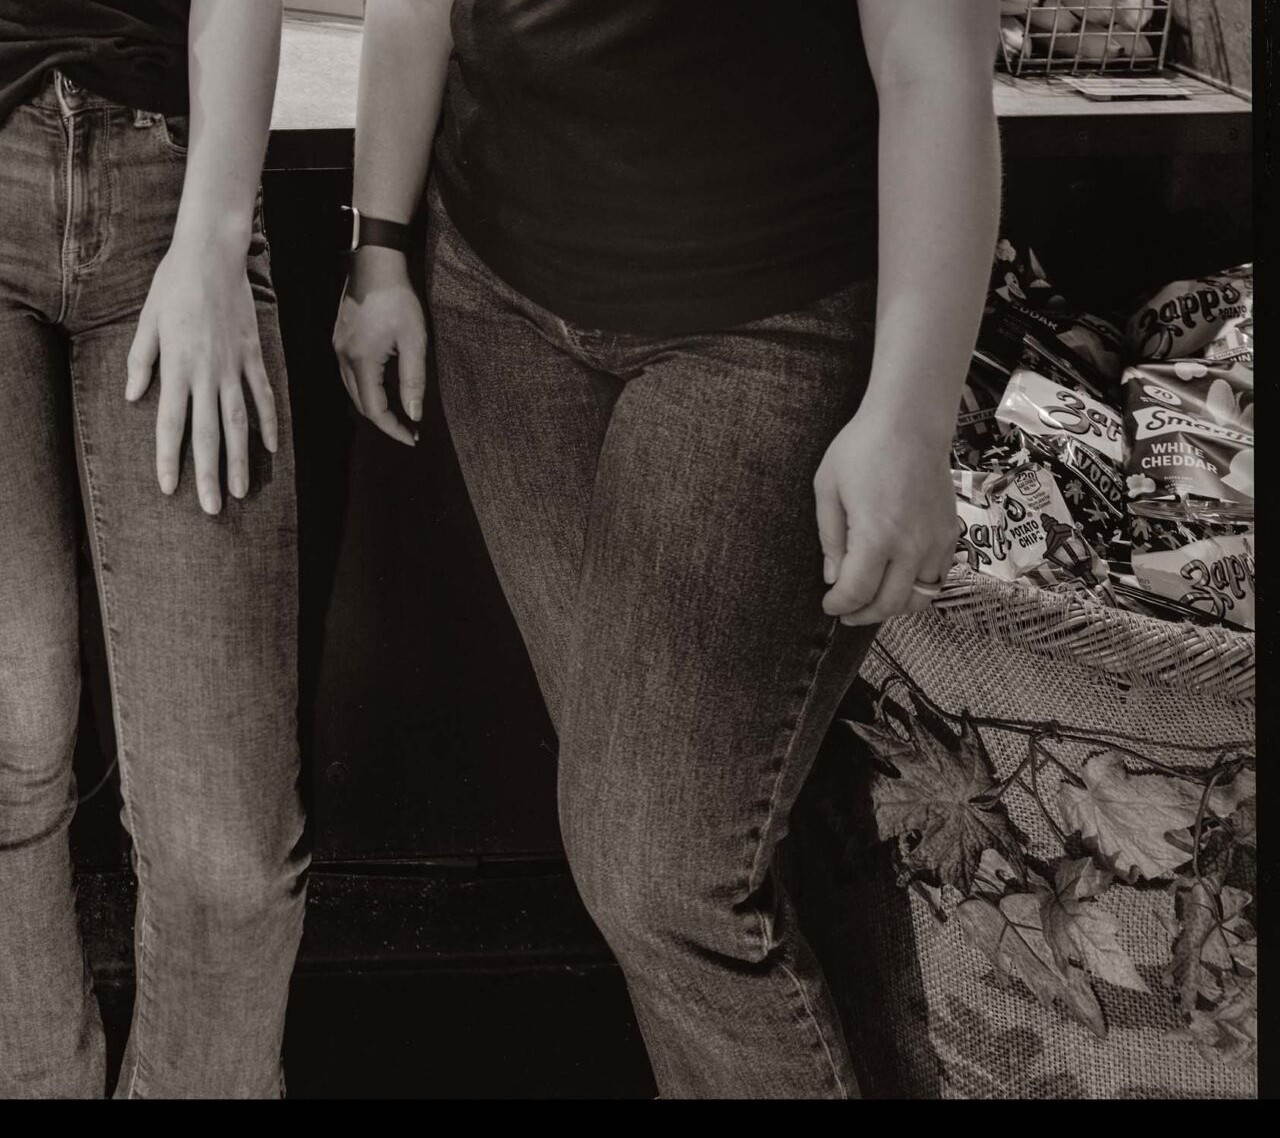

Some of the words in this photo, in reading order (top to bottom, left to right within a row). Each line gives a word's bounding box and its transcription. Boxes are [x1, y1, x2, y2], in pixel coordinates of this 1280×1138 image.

[1154, 388, 1174, 401] 70
[1150, 441, 1205, 459] WHITE
[1141, 454, 1219, 475] CHEDDAR
[1009, 519, 1040, 540] POTATO
